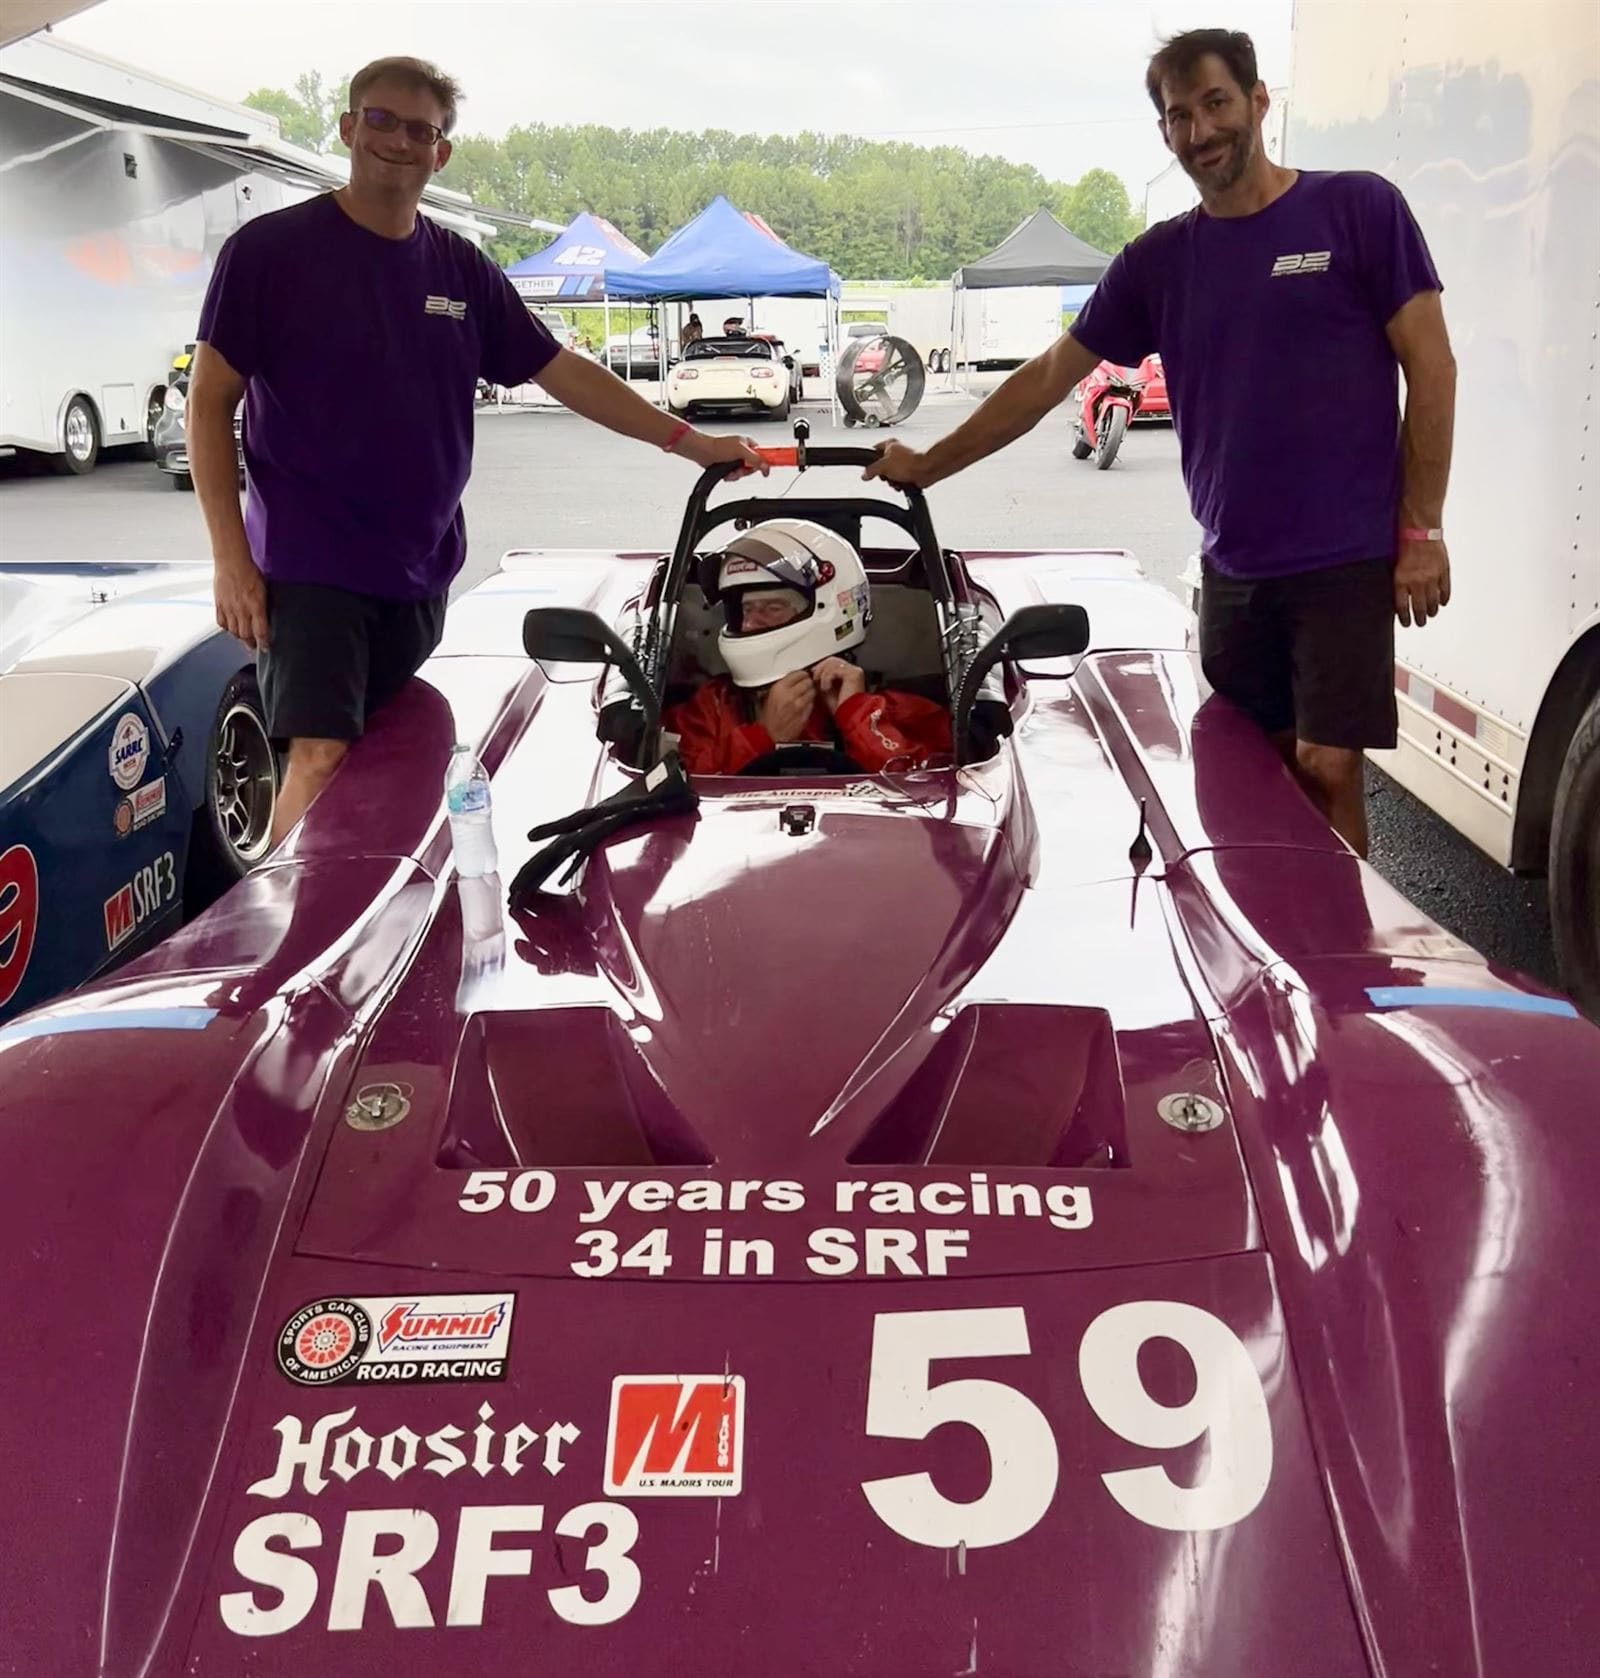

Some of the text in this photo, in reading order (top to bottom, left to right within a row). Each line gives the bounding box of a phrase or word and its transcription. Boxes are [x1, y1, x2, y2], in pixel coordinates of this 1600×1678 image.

[552, 245, 607, 266] 42
[514, 279, 554, 288] GETHER
[133, 851, 176, 923] SRF3
[459, 1171, 1094, 1230] 50 years racing
[571, 1228, 970, 1277] 34 in SRF
[283, 1302, 369, 1345] SPORTS CAR CLUB
[285, 1354, 359, 1381] OF AMERICA
[356, 1361, 502, 1380] ROAD RACING
[861, 1300, 1274, 1549] 59
[247, 1402, 580, 1498] Hoosier
[660, 1479, 702, 1487] MAJORS
[706, 1479, 734, 1487] TOUR
[220, 1502, 642, 1637] SRF3
